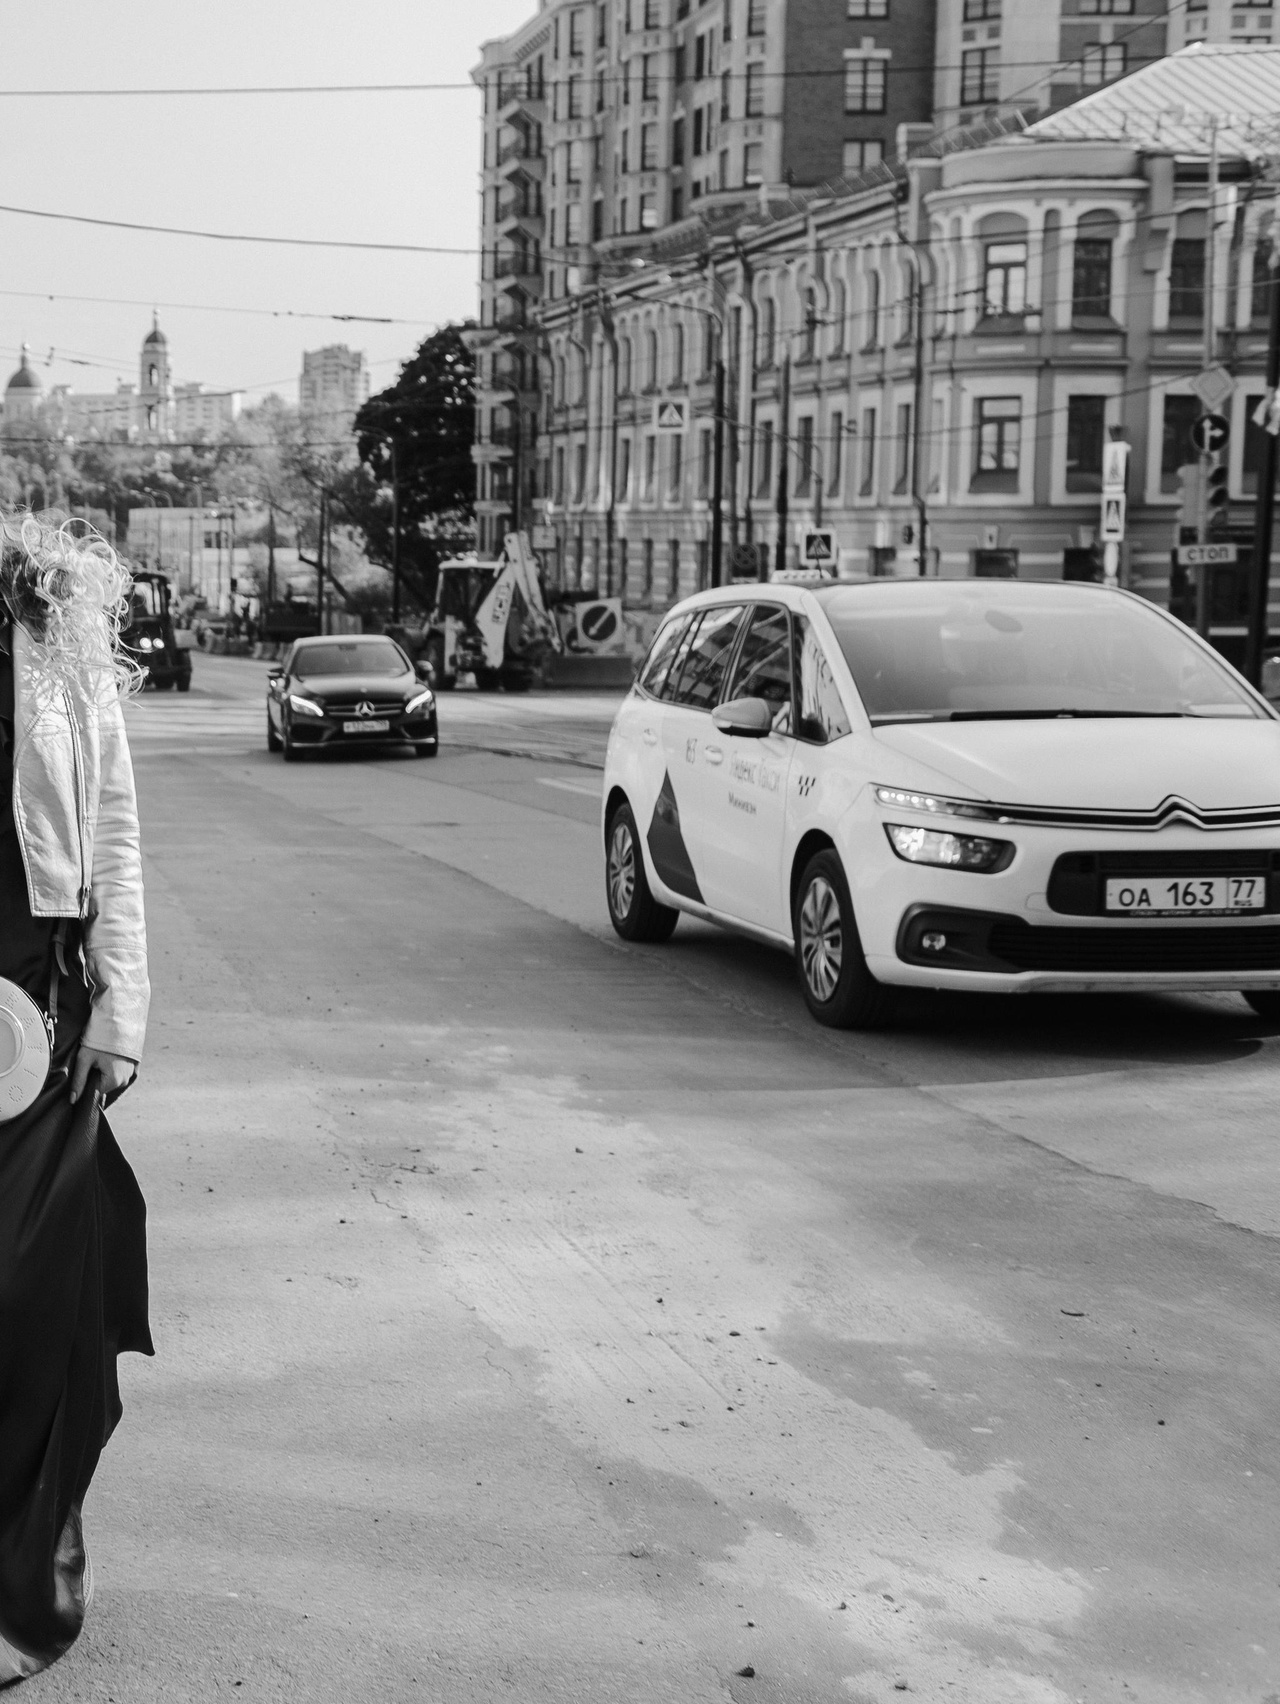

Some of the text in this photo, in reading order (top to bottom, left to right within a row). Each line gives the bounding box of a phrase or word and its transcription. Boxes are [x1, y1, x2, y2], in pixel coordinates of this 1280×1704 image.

[1187, 546, 1229, 560] СТОП
[1167, 881, 1214, 907] 163
[1231, 879, 1257, 898] 77
